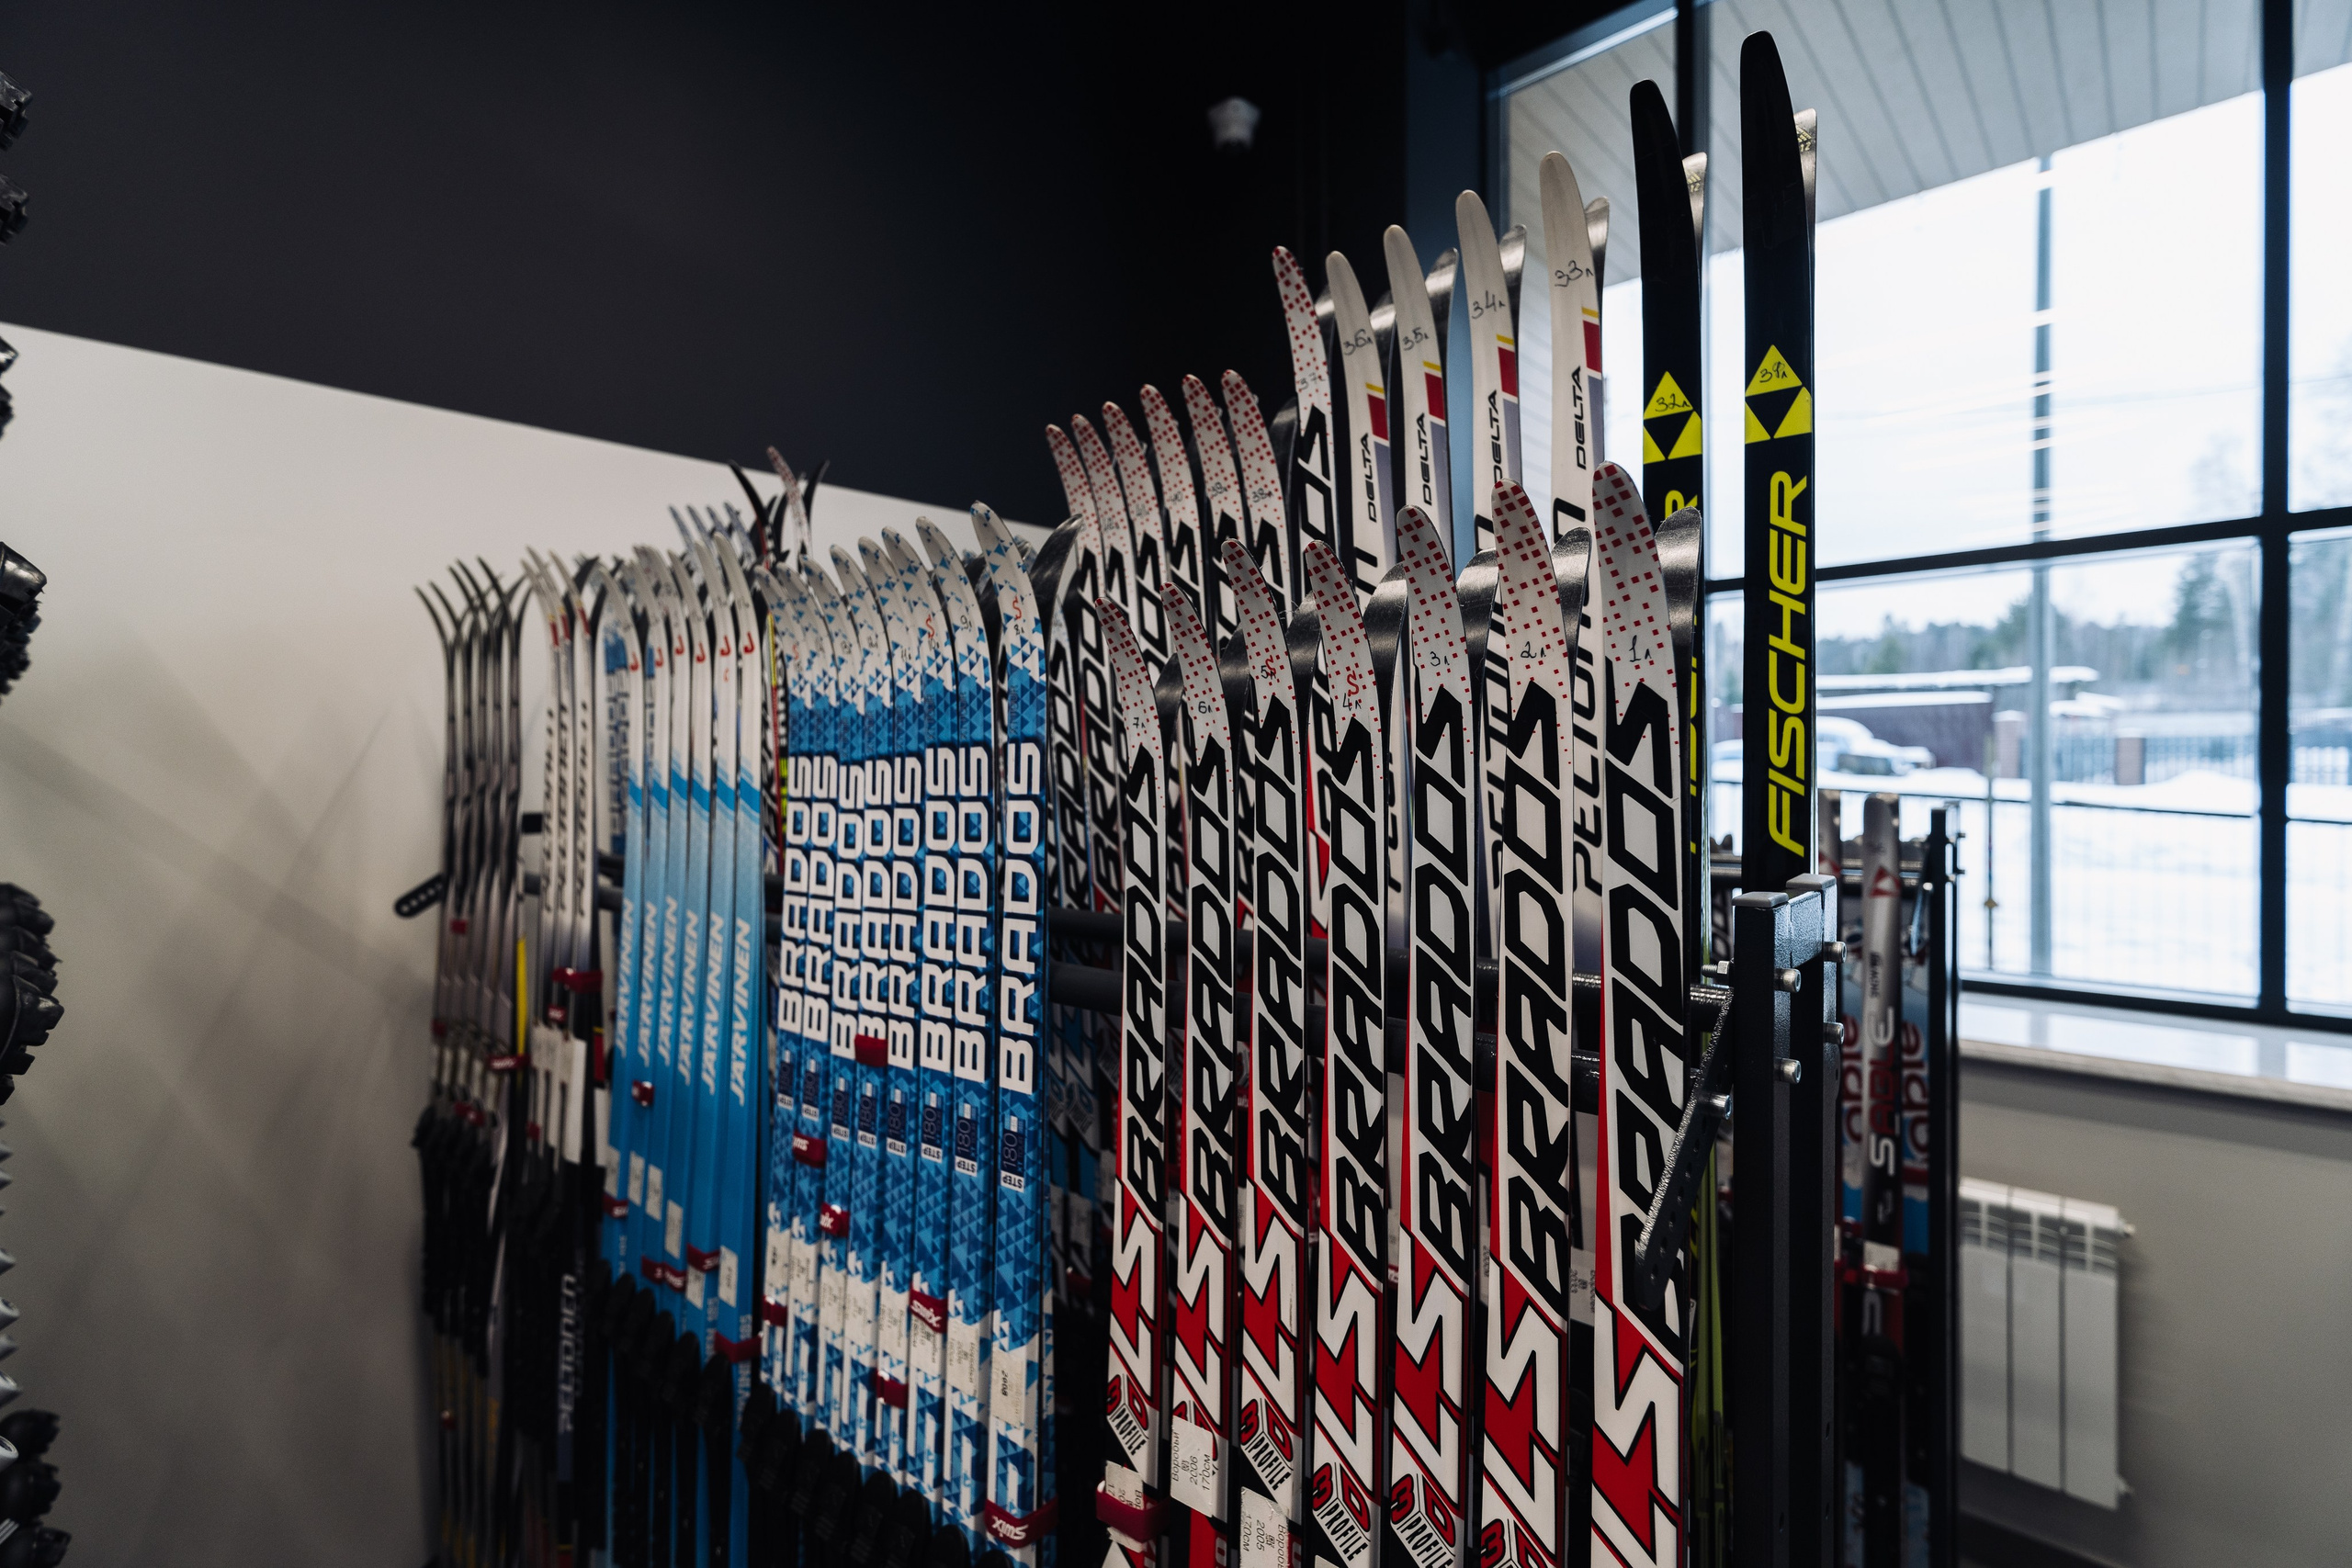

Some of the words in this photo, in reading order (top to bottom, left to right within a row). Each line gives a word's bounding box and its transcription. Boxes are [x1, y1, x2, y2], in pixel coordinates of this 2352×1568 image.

[1361, 432, 1377, 523] DELTA
[1418, 413, 1432, 506] DELTA
[1487, 389, 1505, 481] DELTA
[1576, 365, 1589, 470] DELTA
[1767, 471, 1808, 858] FISCHER
[778, 755, 811, 1034] BRADOS
[803, 755, 838, 1043] BRADOS
[831, 764, 865, 1061] BRADOS
[888, 756, 922, 1070] BRADOS
[920, 747, 956, 1073] BRADOS
[954, 745, 989, 1083] BRADOS
[999, 742, 1041, 1096] BRADOS
[1125, 742, 1164, 1223] BRADOS
[1191, 734, 1233, 1241] BRADOS
[1254, 694, 1305, 1227] BRADOS
[1331, 716, 1385, 1282] BRADOS
[1415, 686, 1472, 1287] BRADOS
[1504, 680, 1570, 1319] BRADOS
[1001, 1132, 1018, 1168] 180
[1110, 1405, 1148, 1456] PROFILE
[1250, 1435, 1292, 1491] PROFILE
[1323, 1498, 1368, 1562] PROFILE
